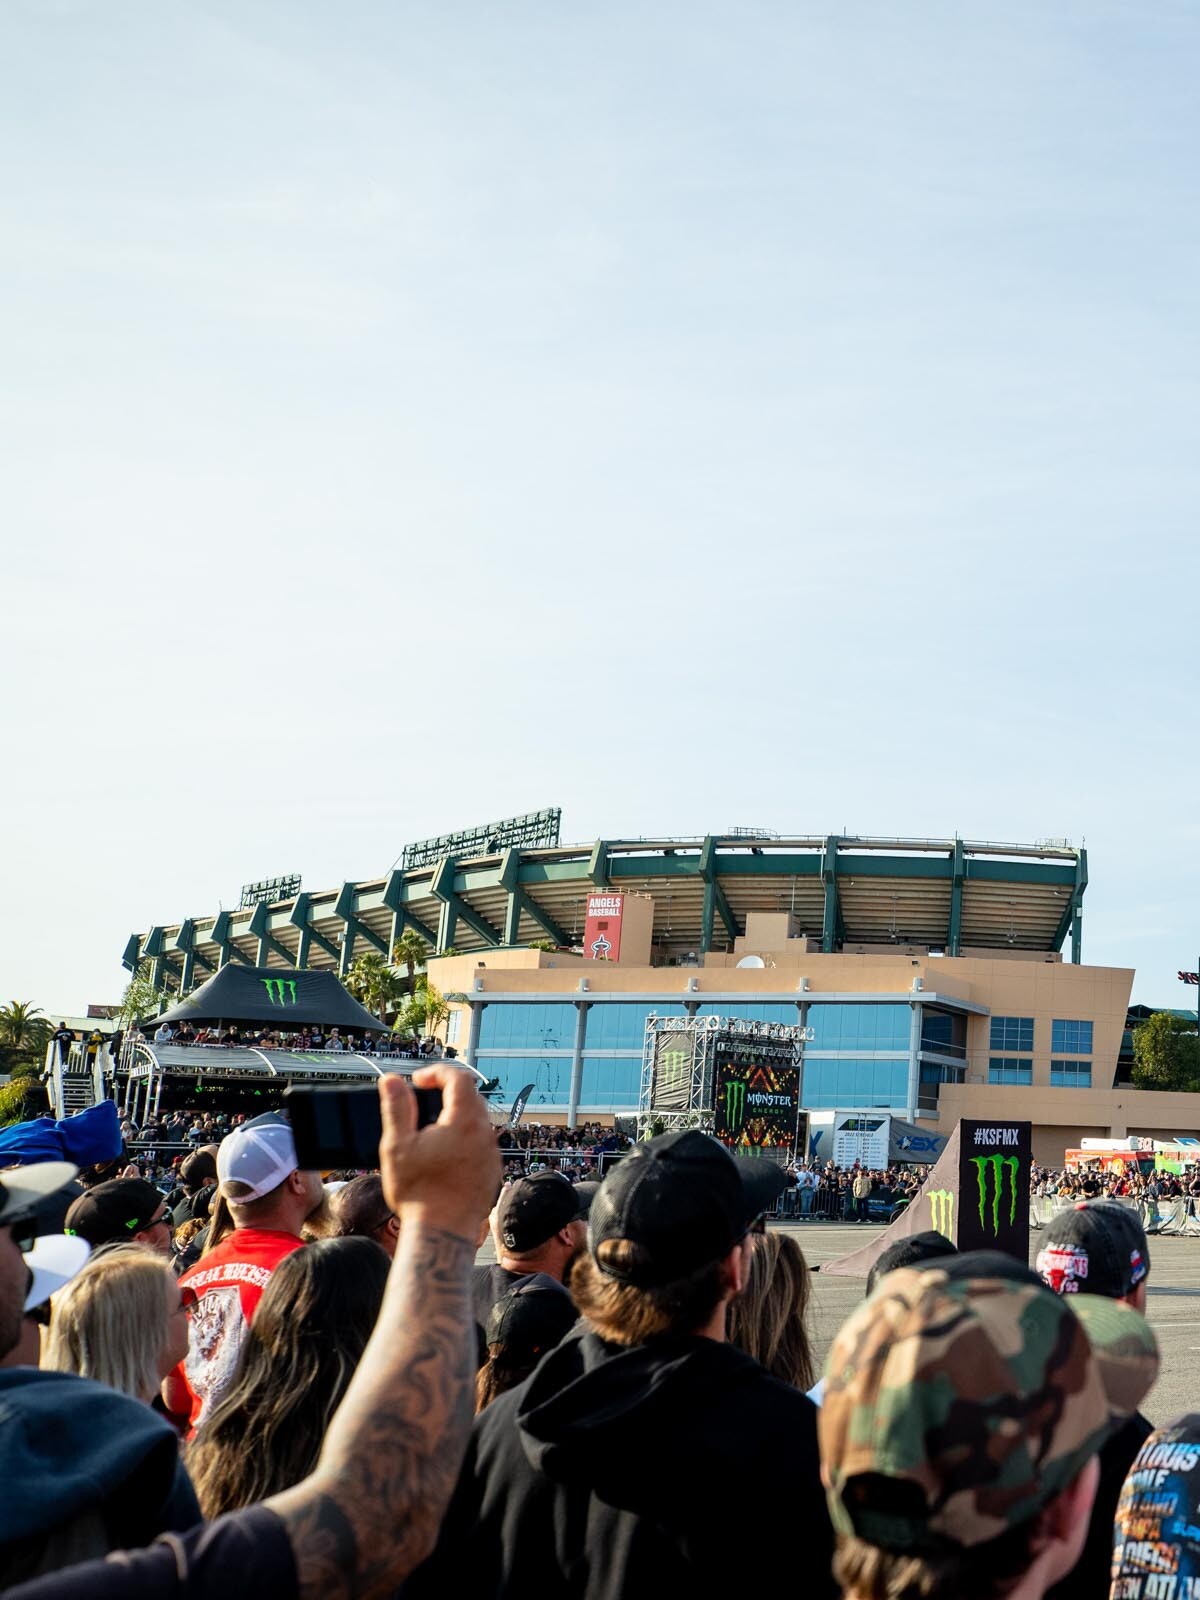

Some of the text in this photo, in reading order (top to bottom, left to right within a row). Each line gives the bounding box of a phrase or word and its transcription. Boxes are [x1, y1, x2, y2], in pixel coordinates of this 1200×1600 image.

[589, 897, 621, 908] ANGELS
[588, 908, 620, 917] BASEBALL
[747, 1092, 791, 1107] MONSTER
[753, 1107, 784, 1115] ENERGY
[974, 1128, 1019, 1146] #KSFMX
